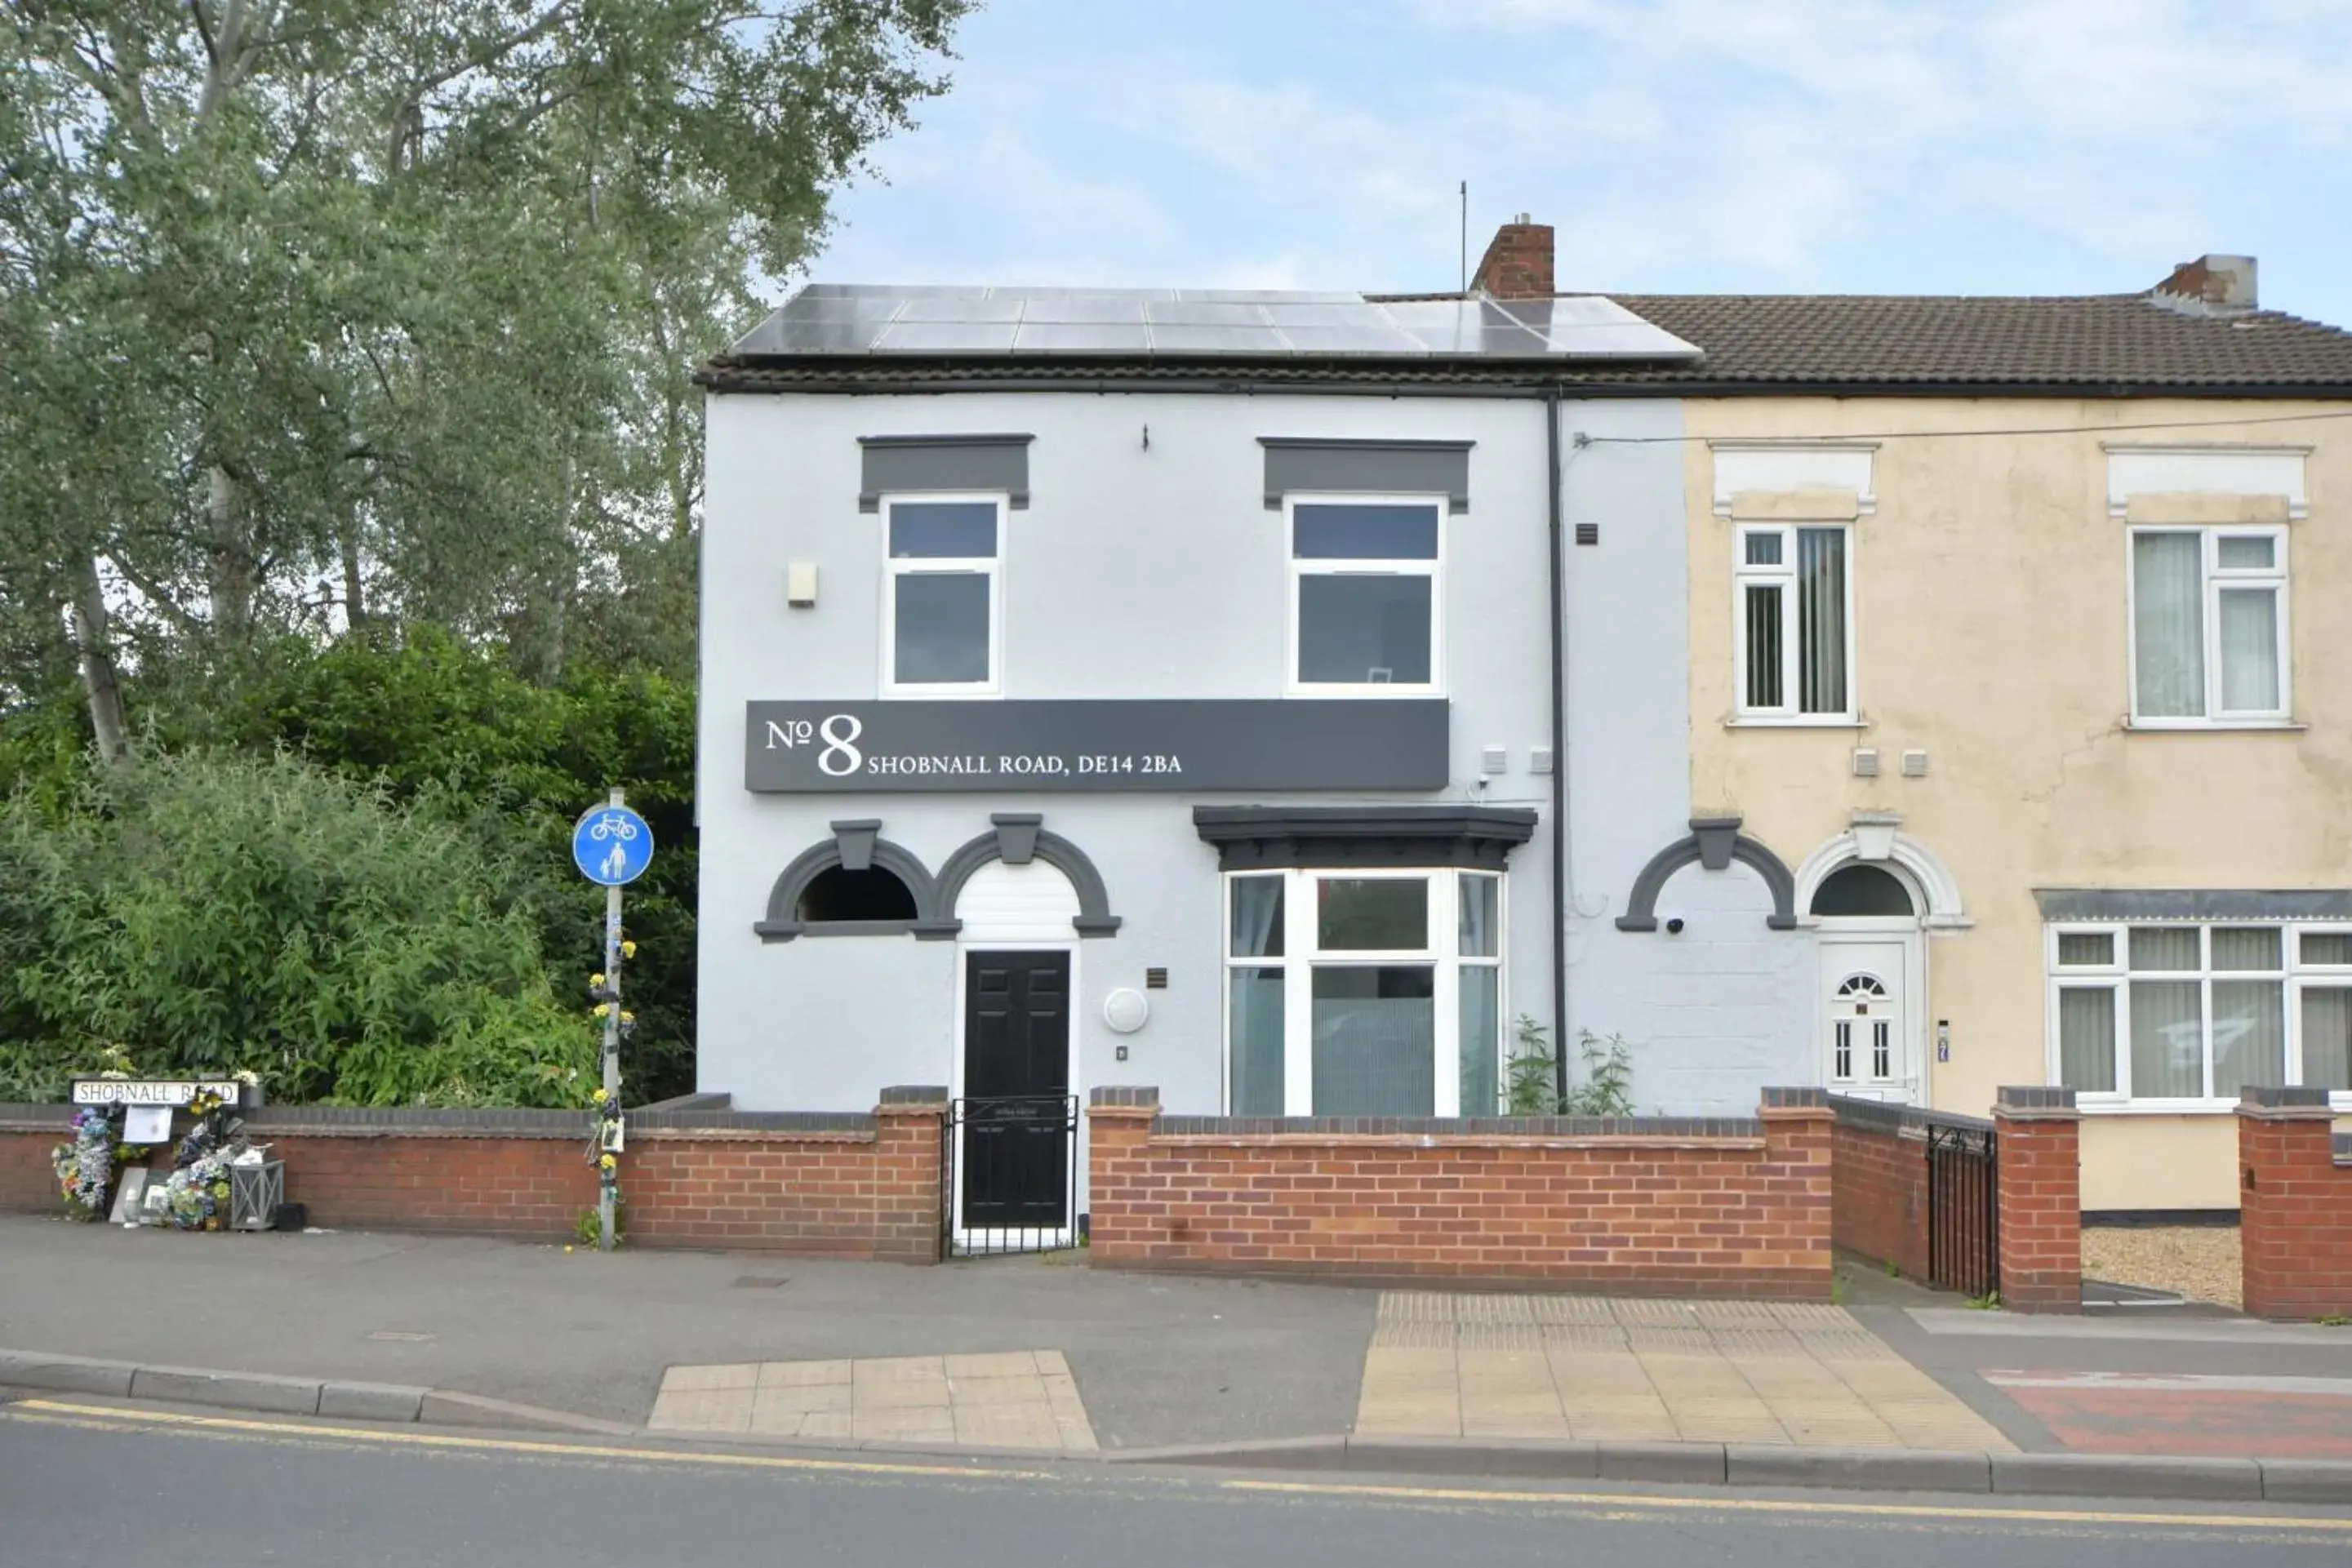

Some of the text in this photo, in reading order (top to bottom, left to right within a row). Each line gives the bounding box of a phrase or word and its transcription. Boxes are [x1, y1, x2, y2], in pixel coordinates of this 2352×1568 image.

[818, 714, 862, 776] 8
[868, 756, 991, 774] SHOBNALL
[999, 756, 1069, 776] ROAD,
[1078, 755, 1133, 773] DE14
[1141, 755, 1182, 773] 2BA
[81, 1084, 233, 1102] SHOBNALL RD
